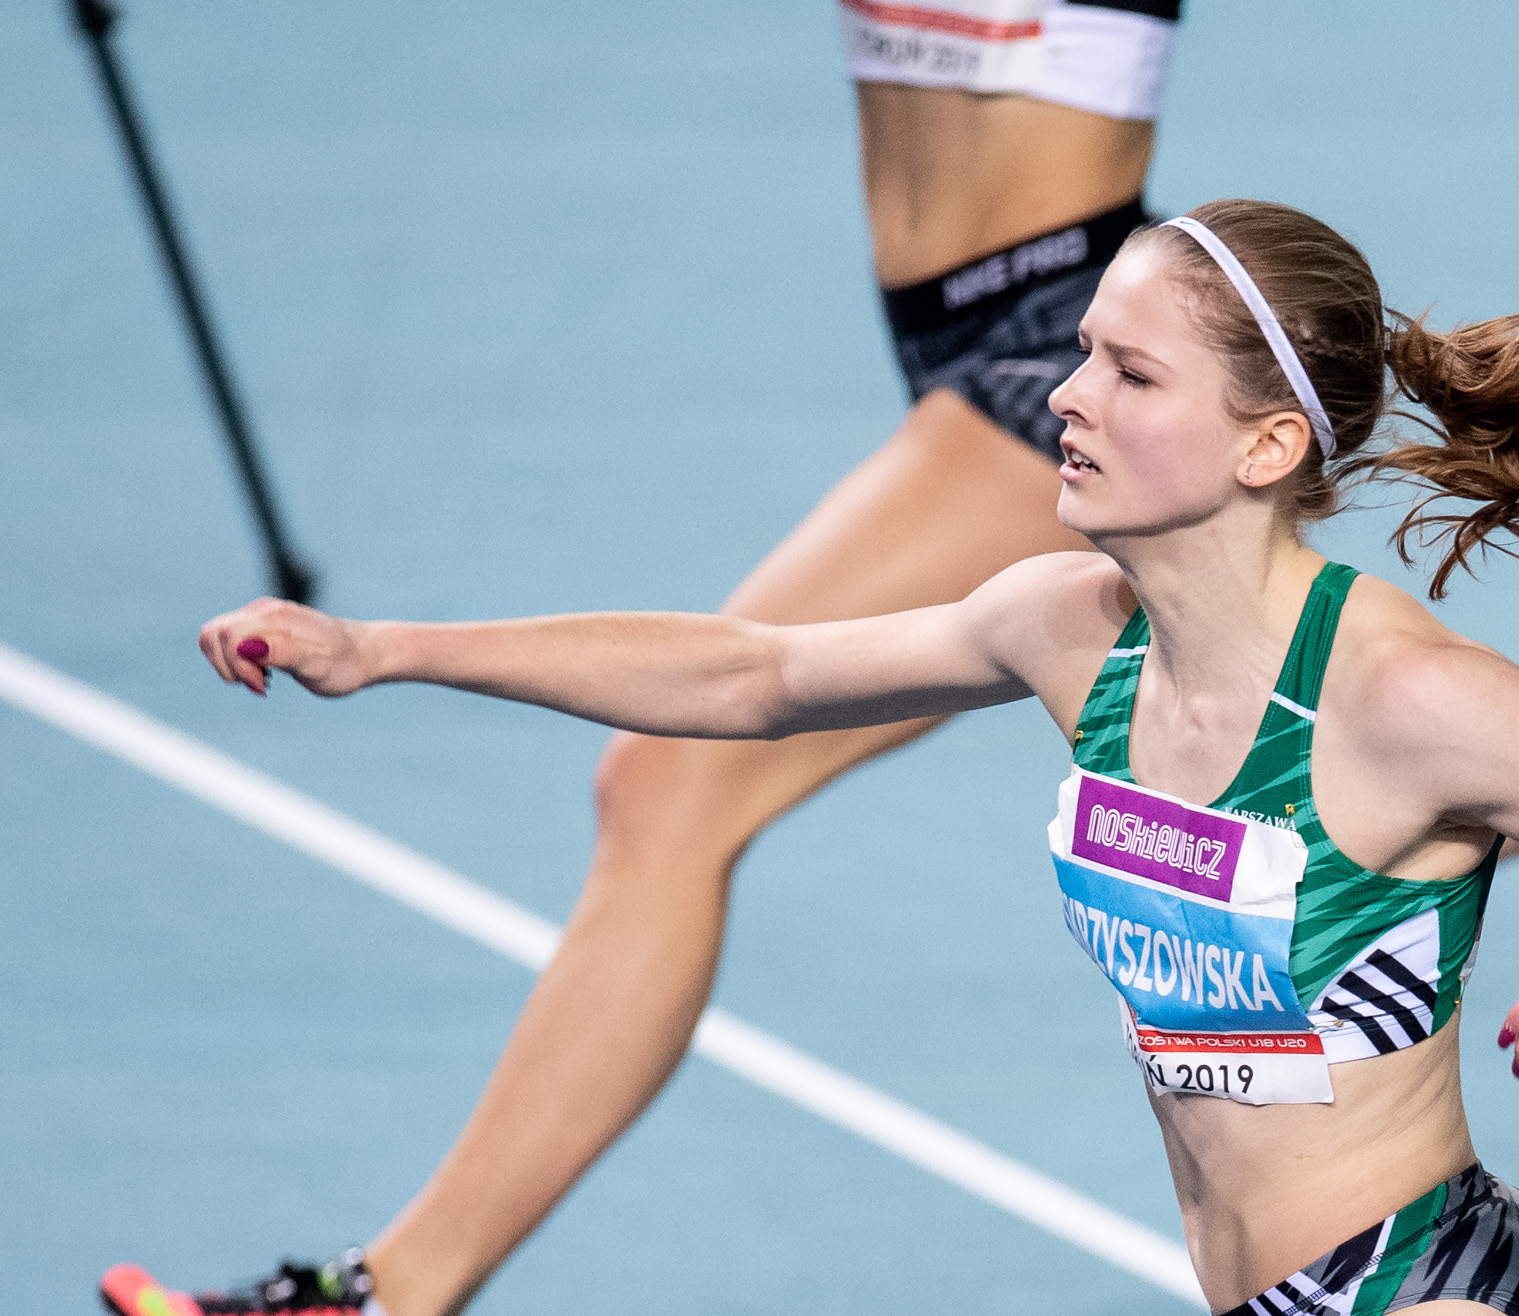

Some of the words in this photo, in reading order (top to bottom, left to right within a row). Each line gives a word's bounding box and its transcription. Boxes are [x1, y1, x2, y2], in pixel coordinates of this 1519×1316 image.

[1062, 892, 1286, 1012] RZYSZOWSKA
[1137, 1034, 1193, 1047] ZOSTWA
[1196, 1037, 1245, 1048] POLSKI
[1247, 1038, 1274, 1048] U18
[1276, 1037, 1307, 1049] U20
[1176, 1063, 1254, 1095] 2019
